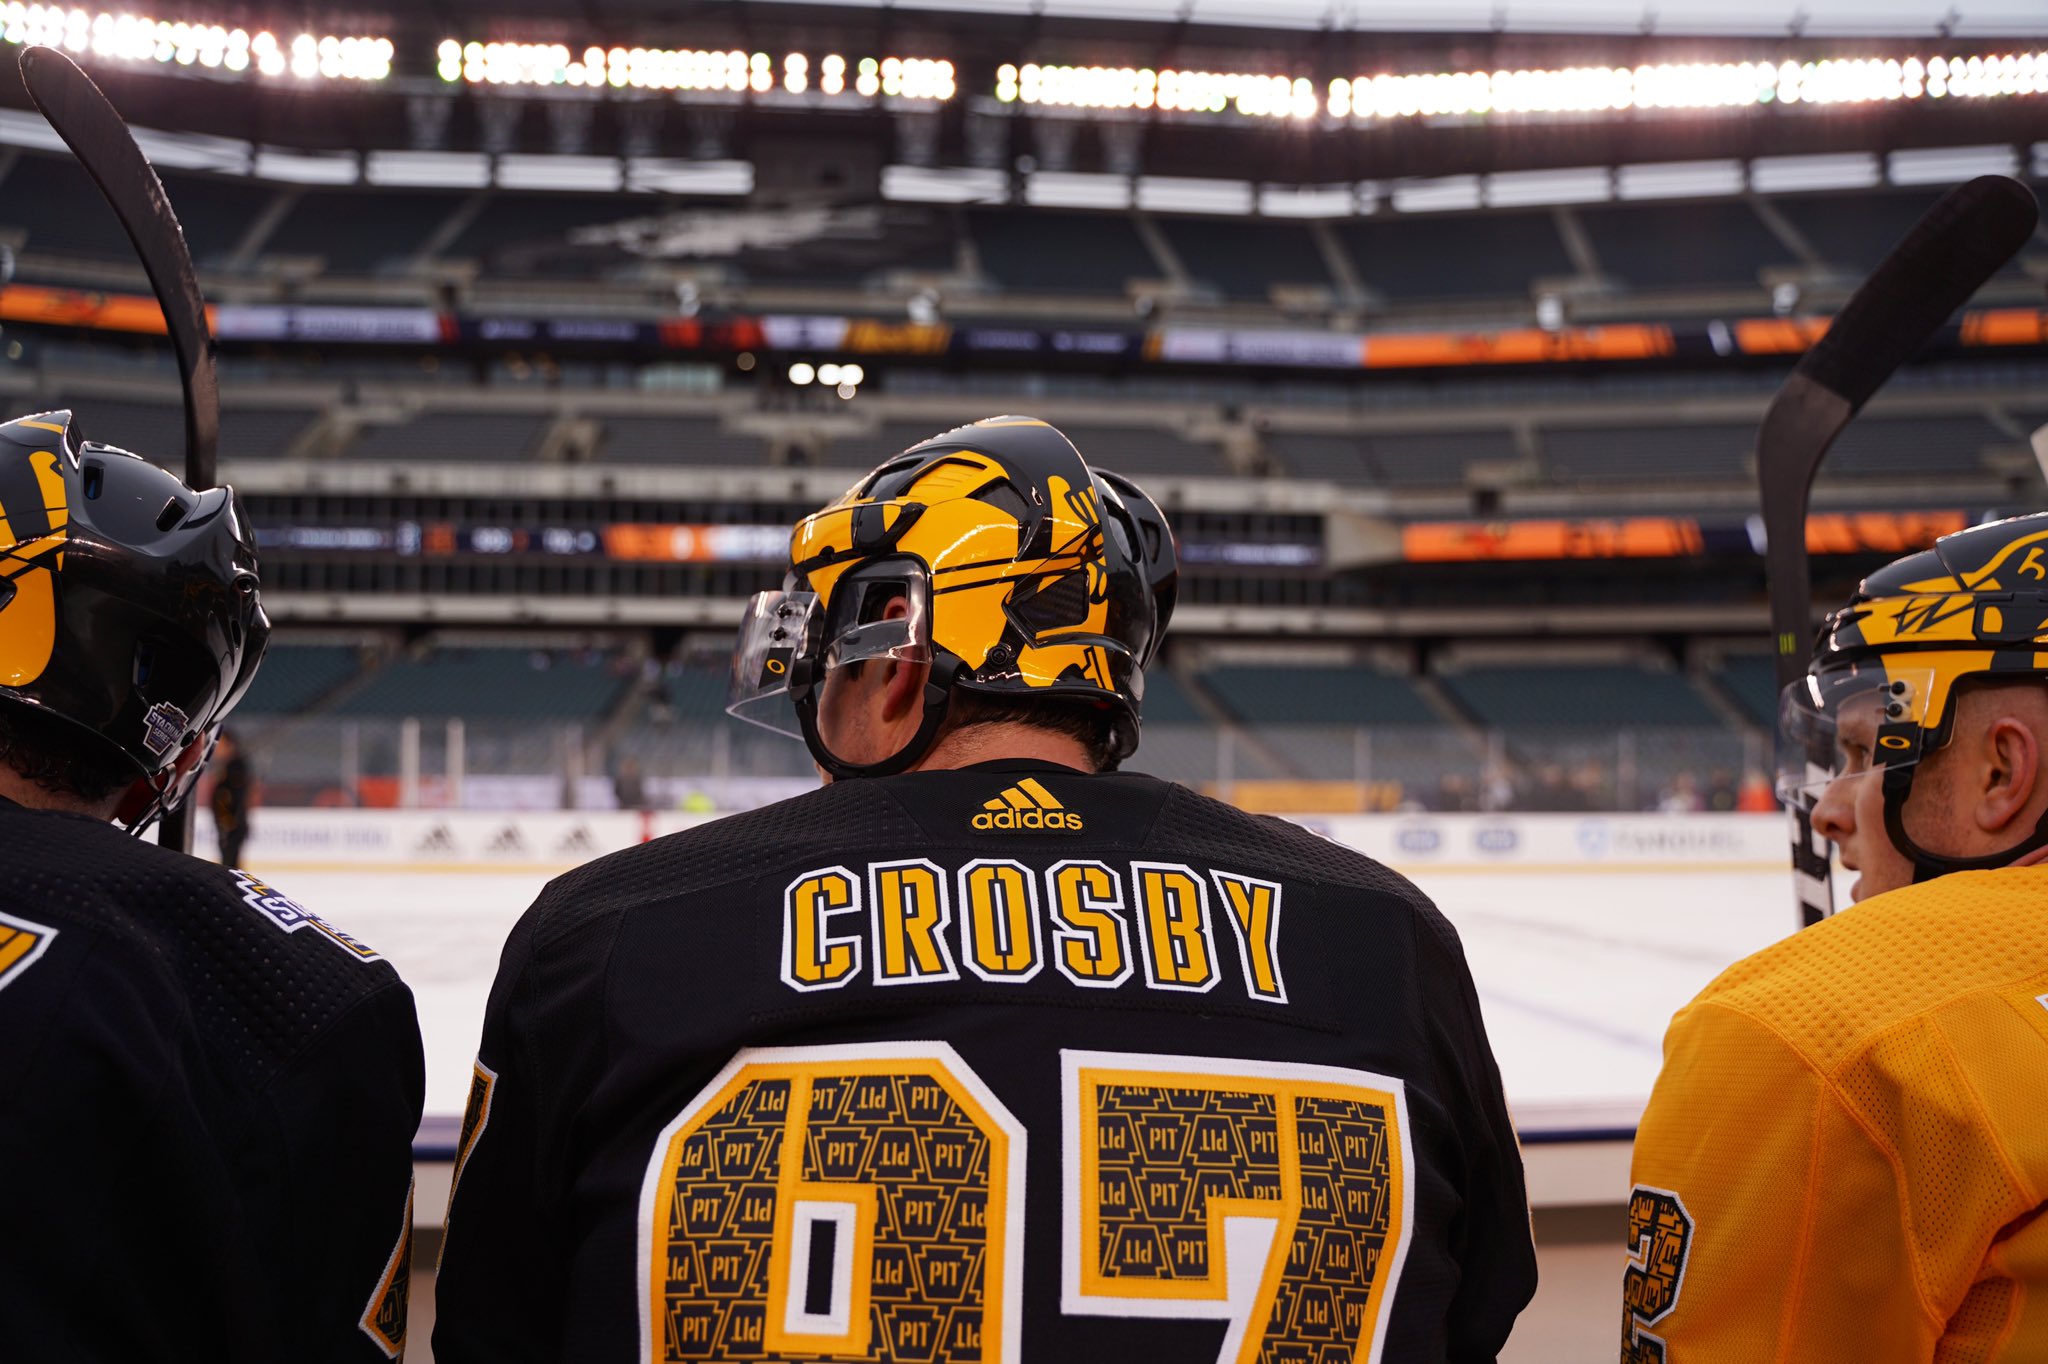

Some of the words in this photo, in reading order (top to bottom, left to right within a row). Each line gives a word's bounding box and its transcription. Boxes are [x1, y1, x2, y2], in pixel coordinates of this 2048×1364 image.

[150, 712, 182, 739] STADIUM
[972, 807, 1083, 831] adidas
[781, 857, 1288, 1004] CROSBY
